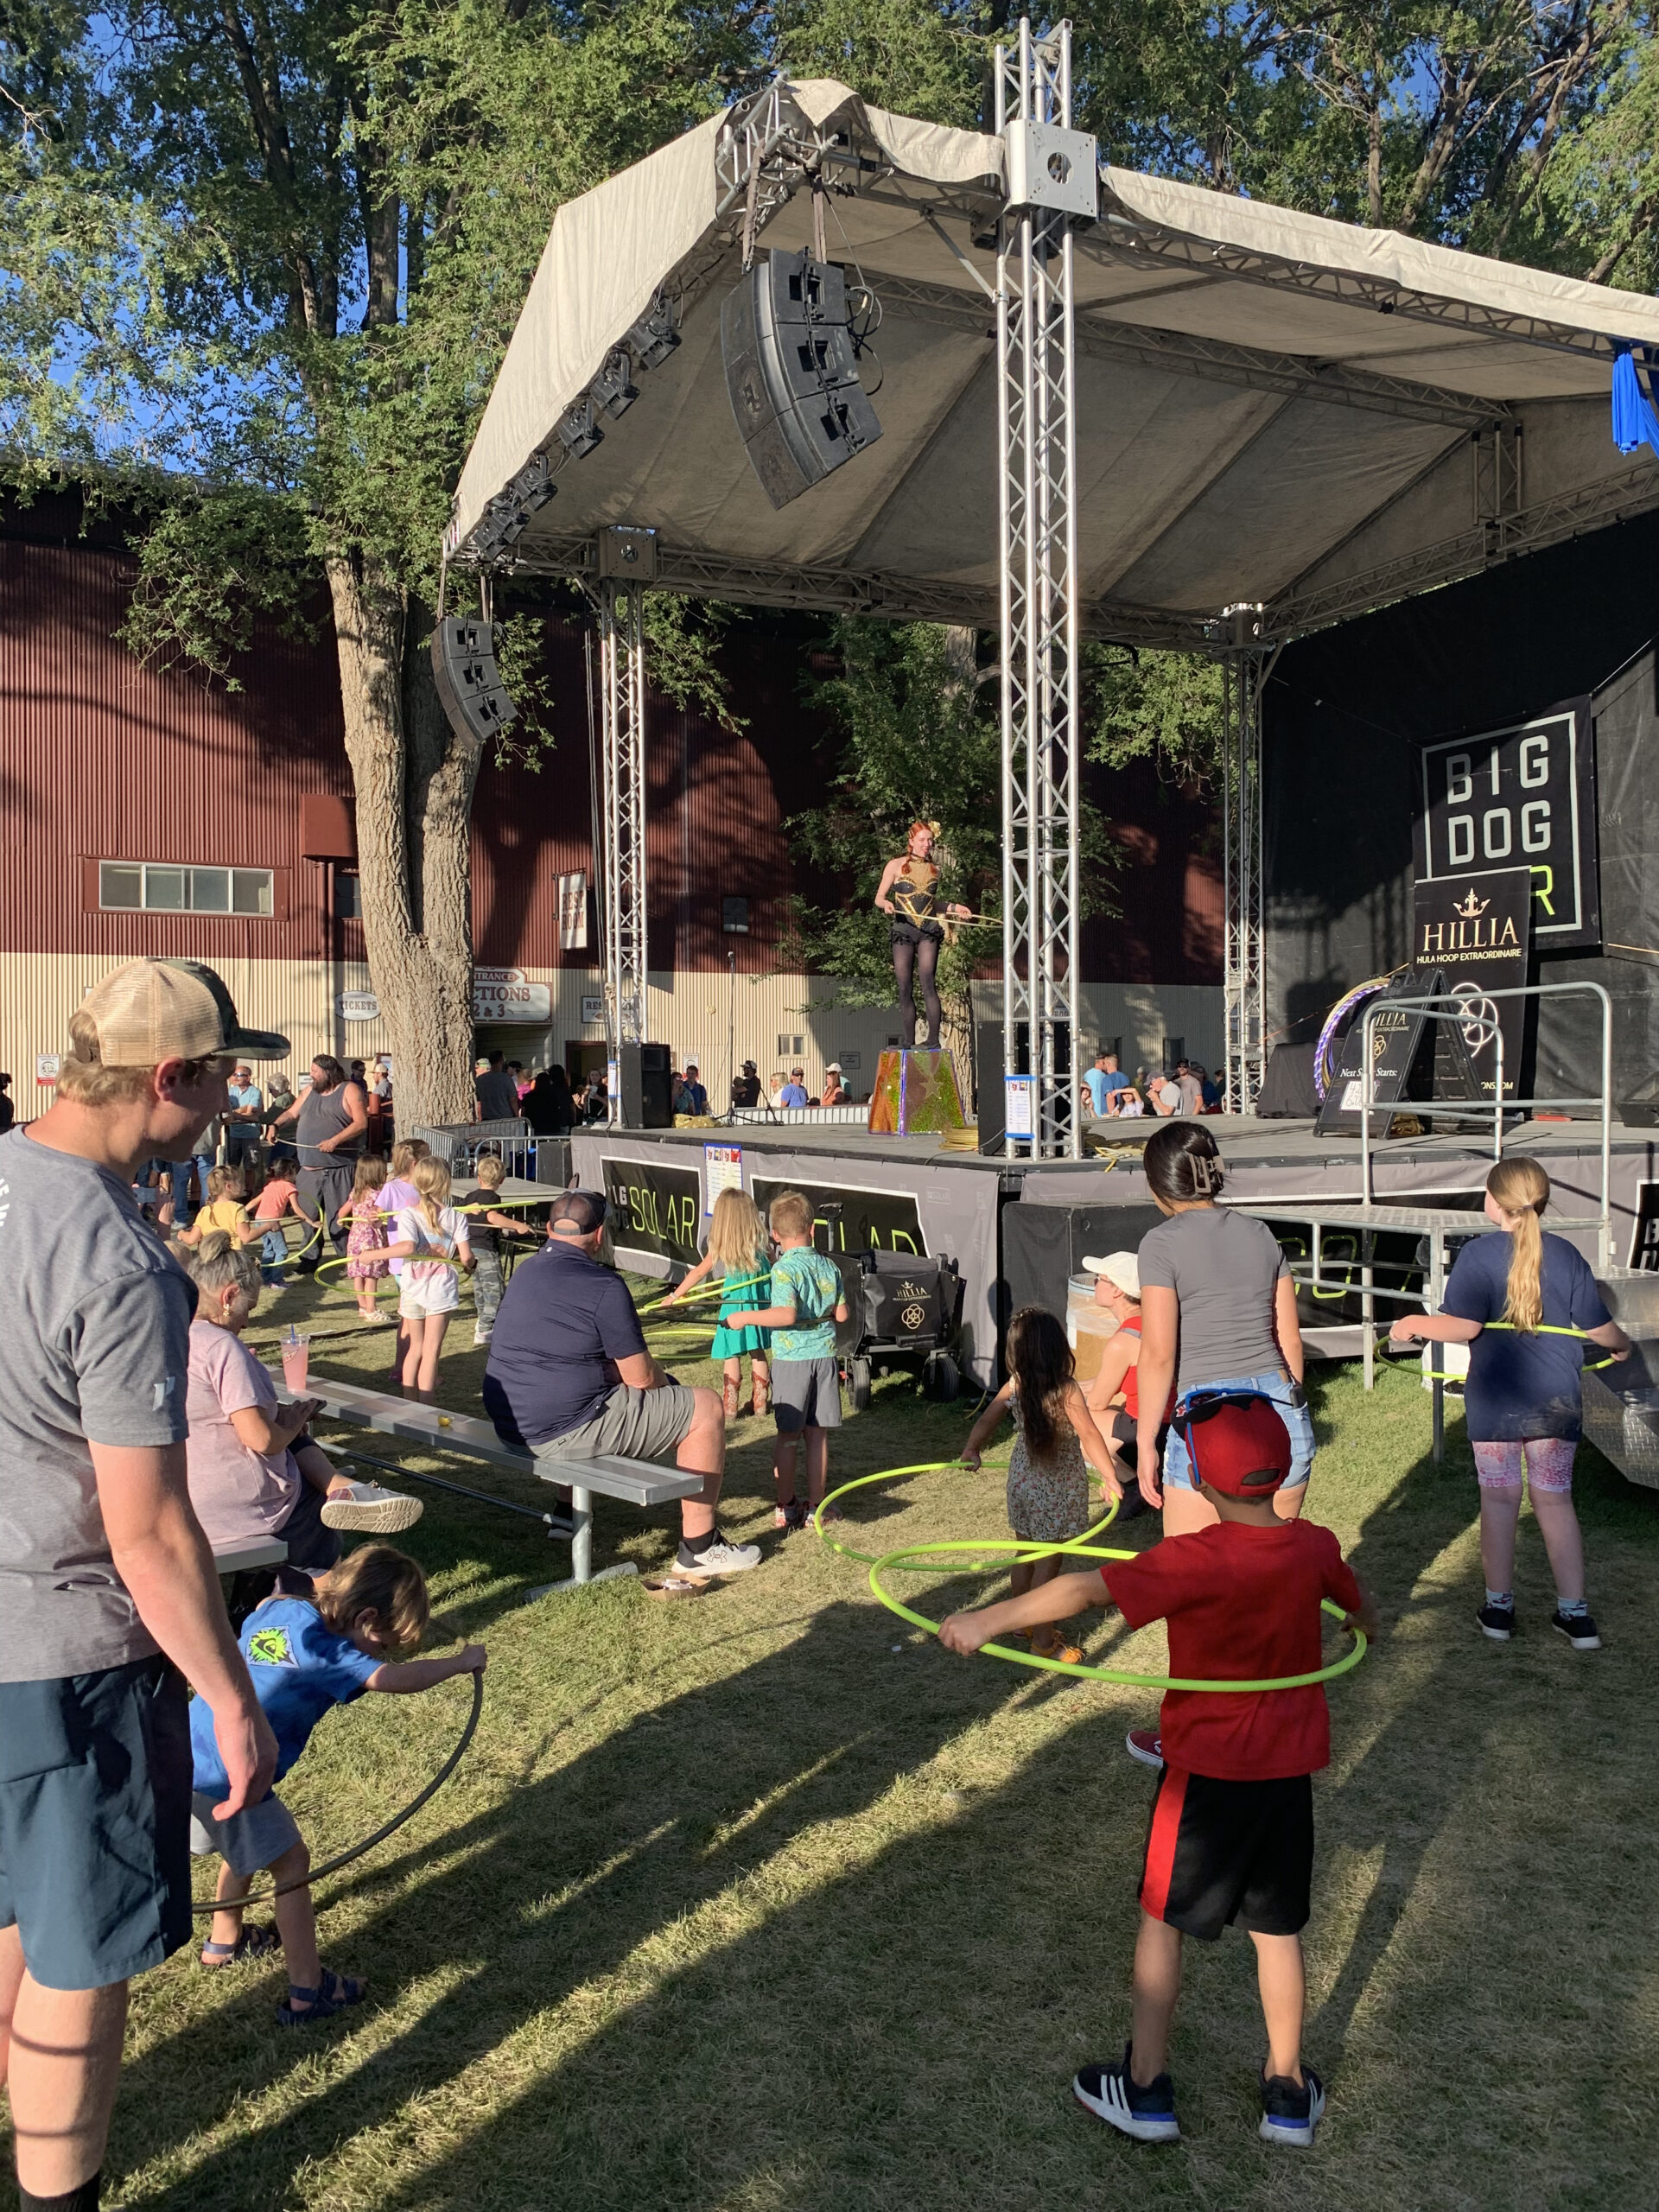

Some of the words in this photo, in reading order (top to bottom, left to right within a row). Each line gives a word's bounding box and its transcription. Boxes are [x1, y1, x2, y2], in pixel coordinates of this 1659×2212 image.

[1446, 734, 1549, 805] BIG
[1447, 799, 1552, 866] DOG
[562, 889, 584, 911] REST
[562, 911, 584, 931] ROOM
[1422, 916, 1520, 952] HILLIA
[1416, 954, 1436, 965] HULA
[1436, 952, 1459, 963] HOOP
[1459, 948, 1522, 962] EXTRAORDINAIRE
[339, 1000, 378, 1011] TICKETS
[497, 1003, 505, 1018] 3
[1376, 1012, 1407, 1027] ILLIA
[1339, 1068, 1356, 1077] Next
[1376, 1067, 1398, 1077] Starts:
[629, 1185, 694, 1249] SOLAR
